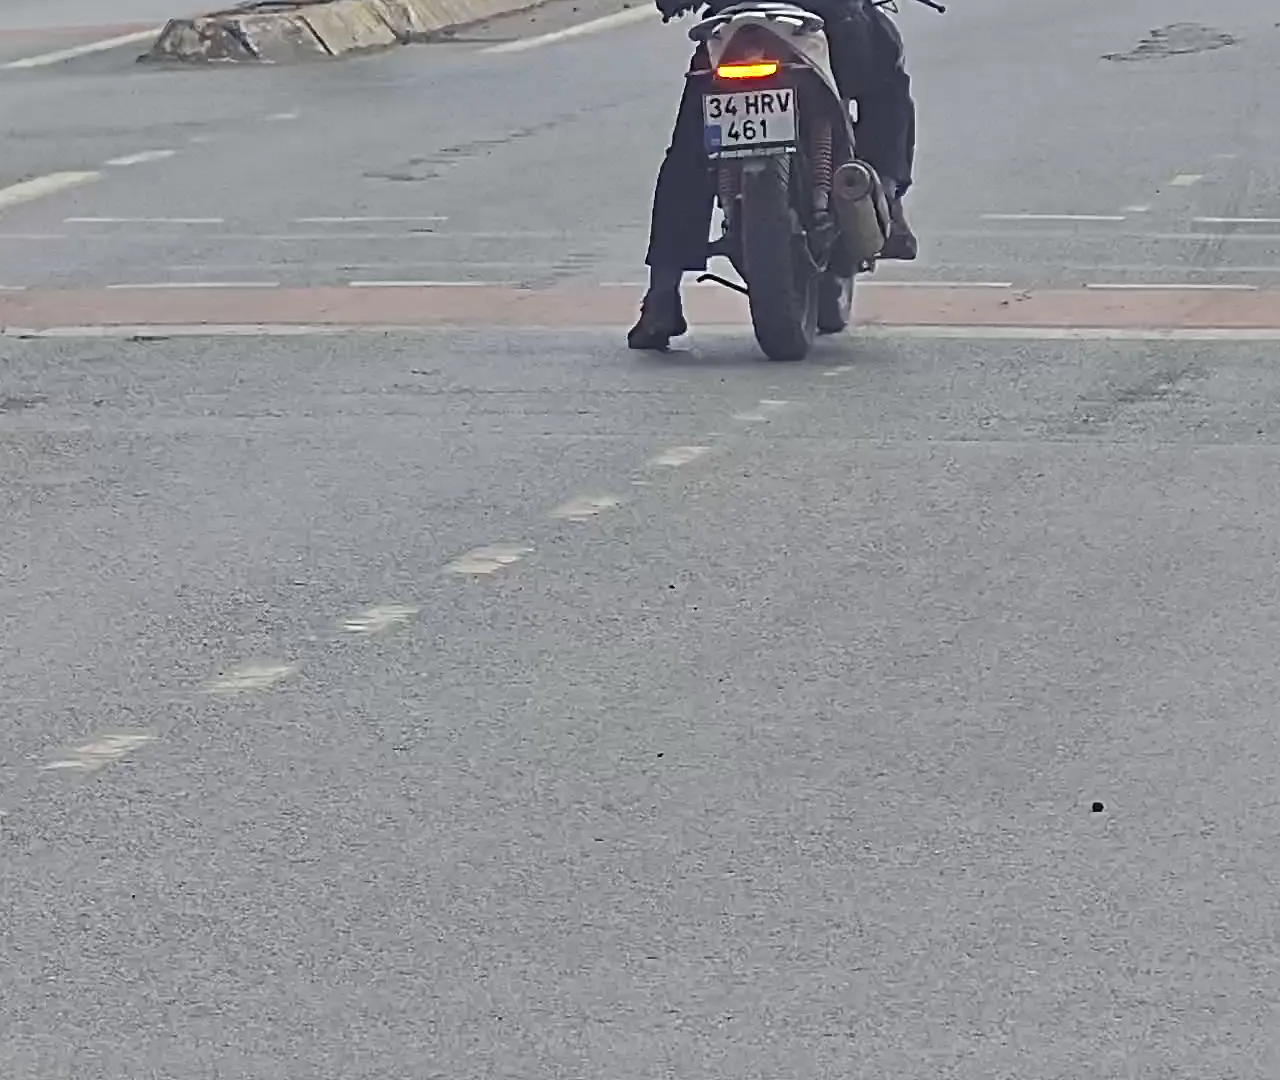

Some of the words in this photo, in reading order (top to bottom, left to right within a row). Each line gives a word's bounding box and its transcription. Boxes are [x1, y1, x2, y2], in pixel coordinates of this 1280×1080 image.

[709, 96, 737, 118] 34
[745, 92, 790, 115] HRV
[727, 120, 767, 141] 461
